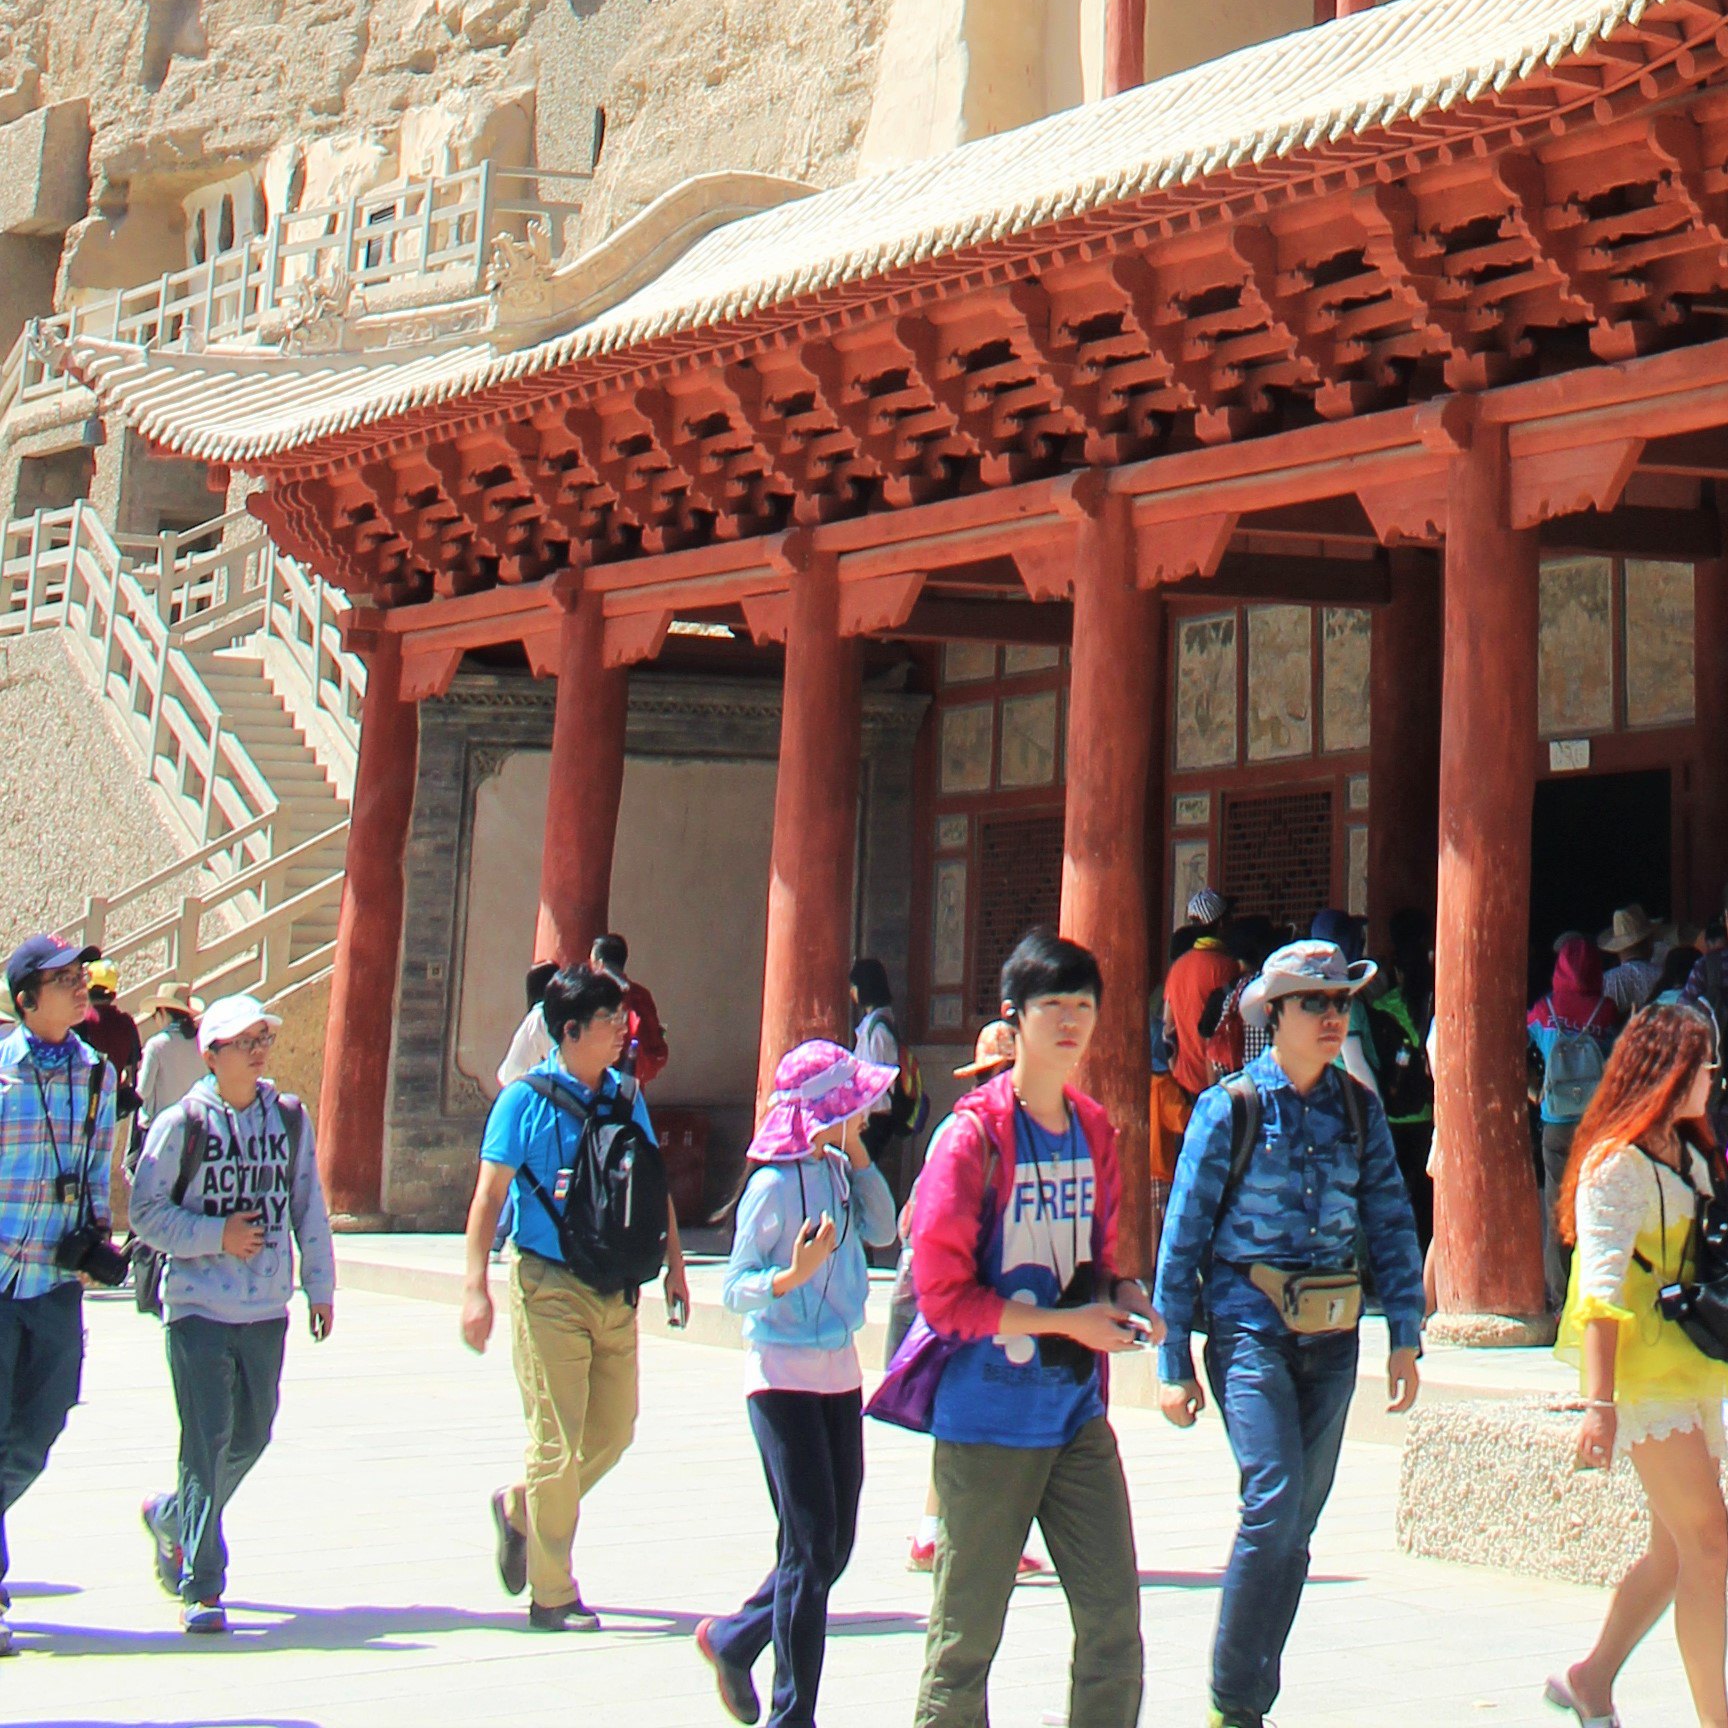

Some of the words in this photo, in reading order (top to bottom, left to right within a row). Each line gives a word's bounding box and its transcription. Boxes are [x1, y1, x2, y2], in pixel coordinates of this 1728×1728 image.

[203, 1133, 287, 1162] BACK
[203, 1164, 287, 1195] ACTION
[1014, 1175, 1094, 1223] FREE
